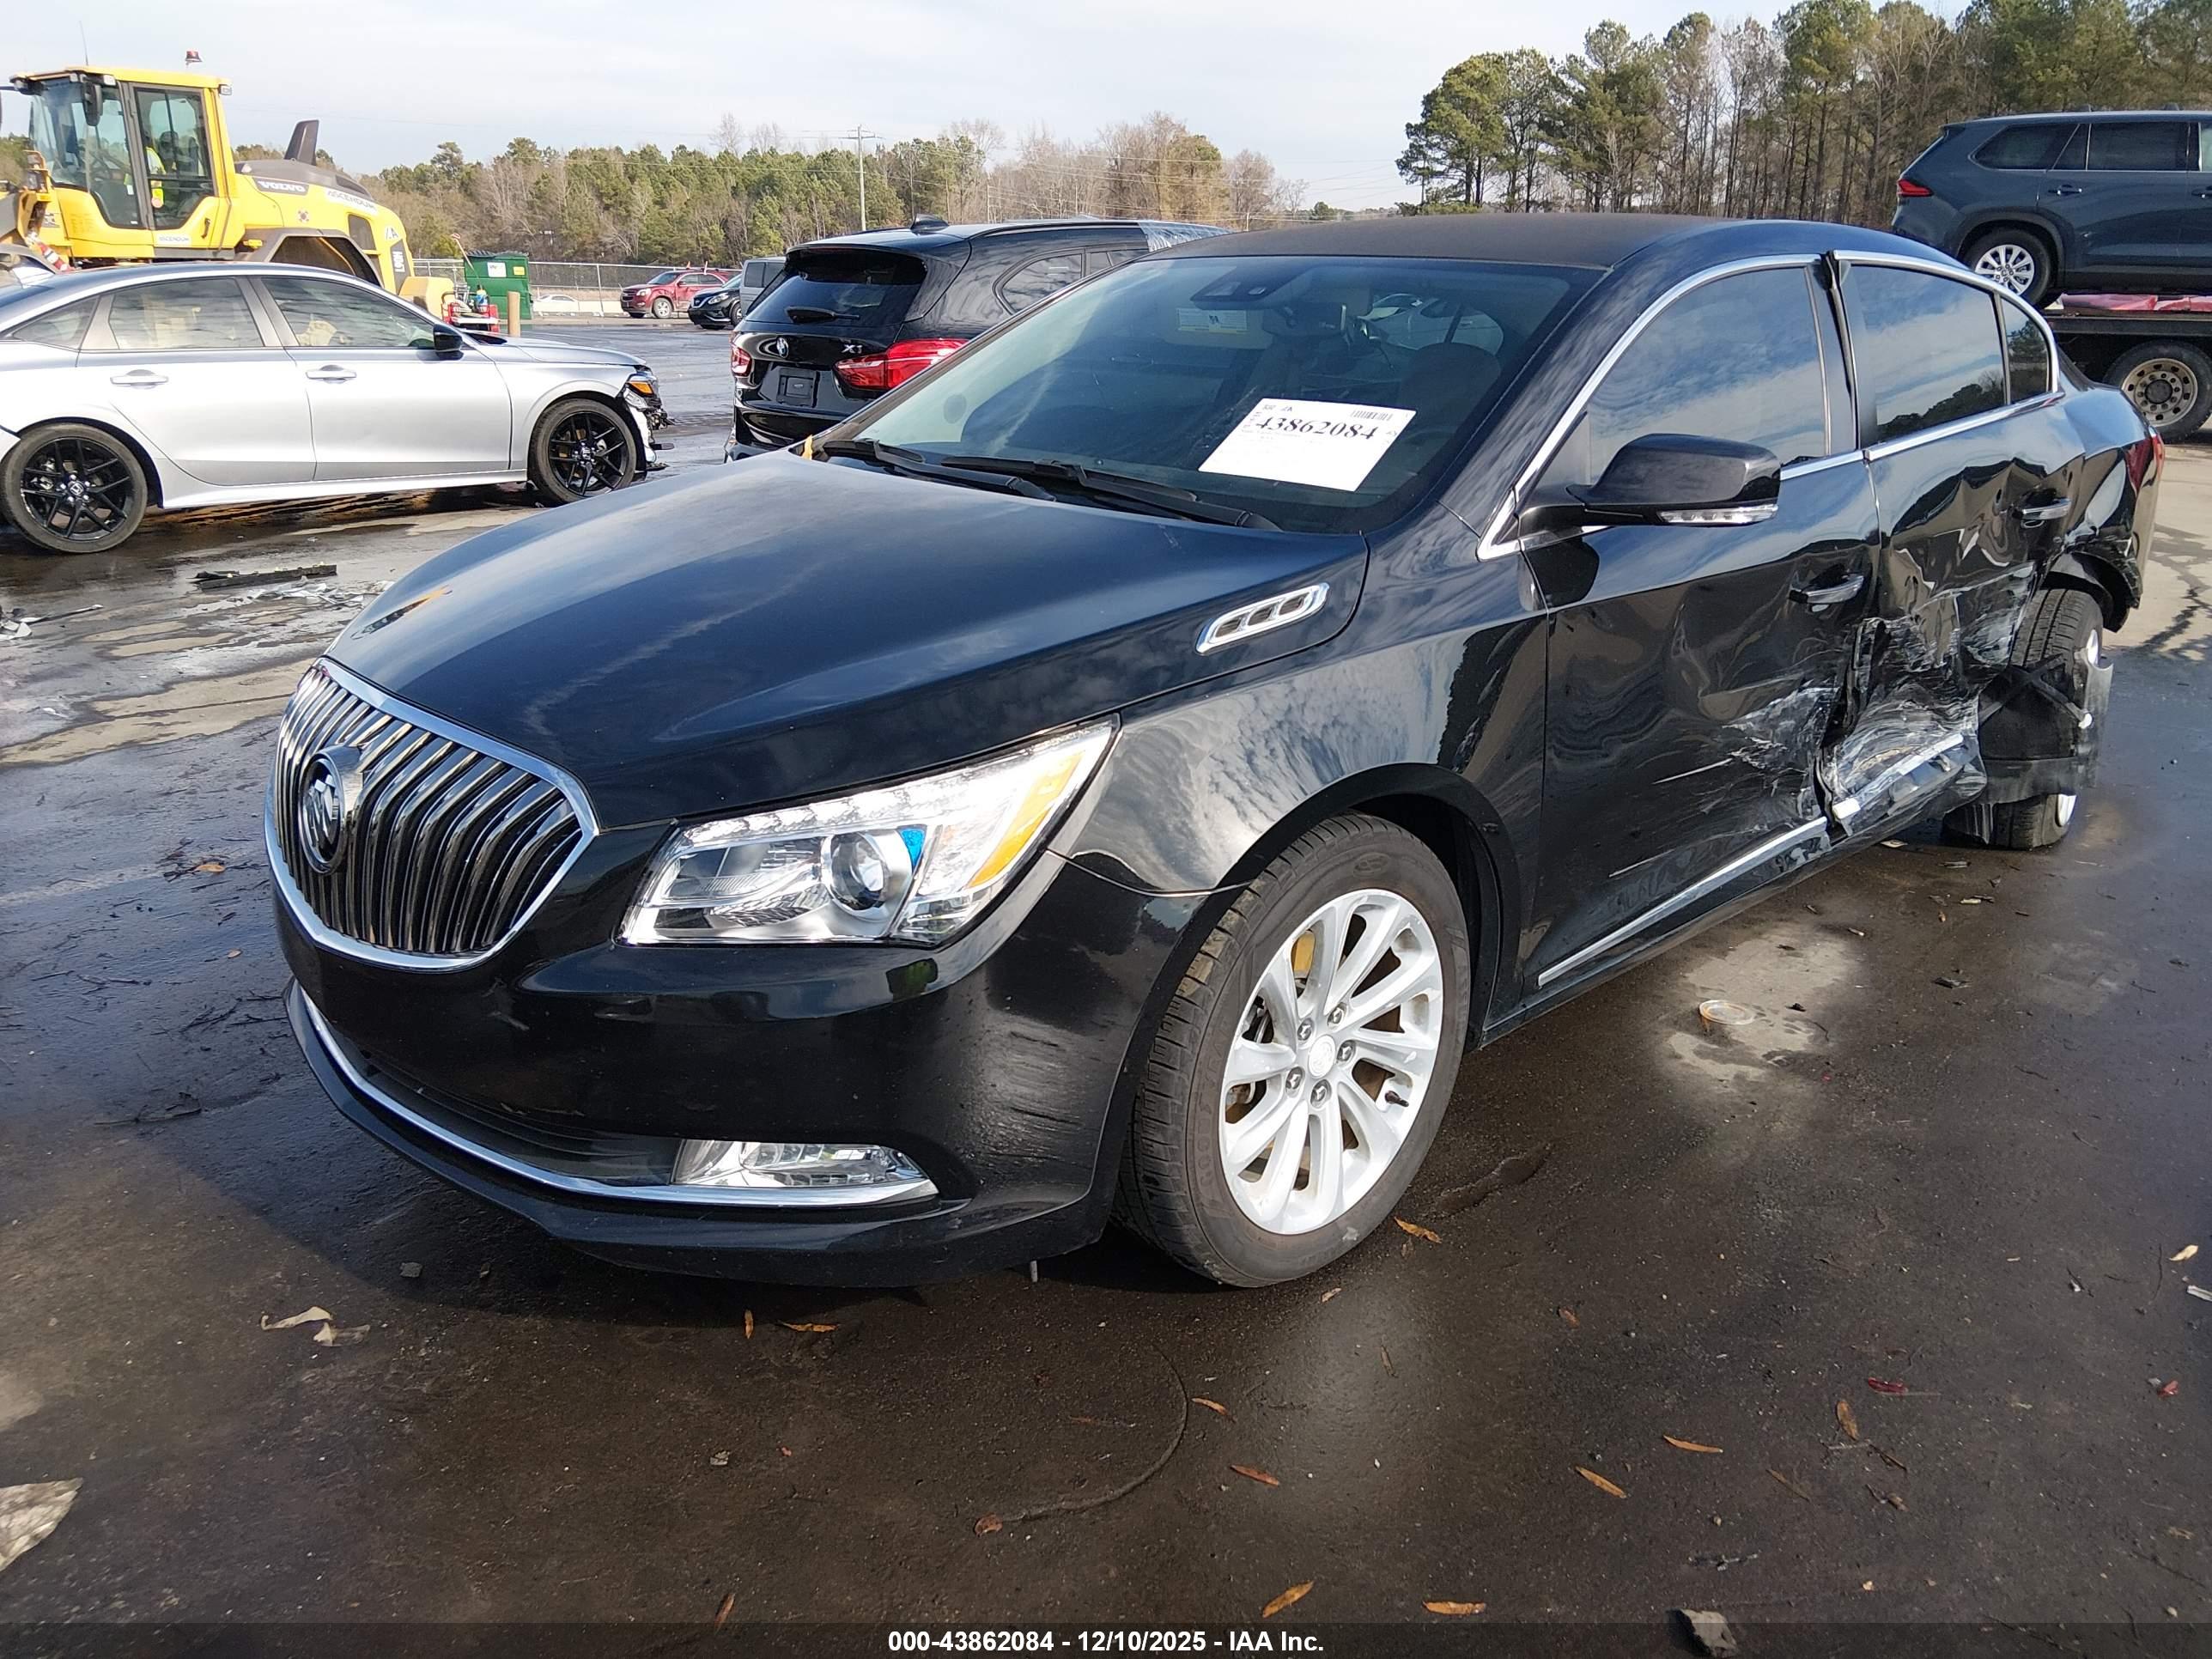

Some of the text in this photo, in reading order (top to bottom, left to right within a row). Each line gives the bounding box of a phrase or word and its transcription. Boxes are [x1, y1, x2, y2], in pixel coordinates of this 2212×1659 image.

[258, 181, 306, 192] VOLVO
[841, 344, 863, 354] X1
[1255, 416, 1379, 440] 43862084
